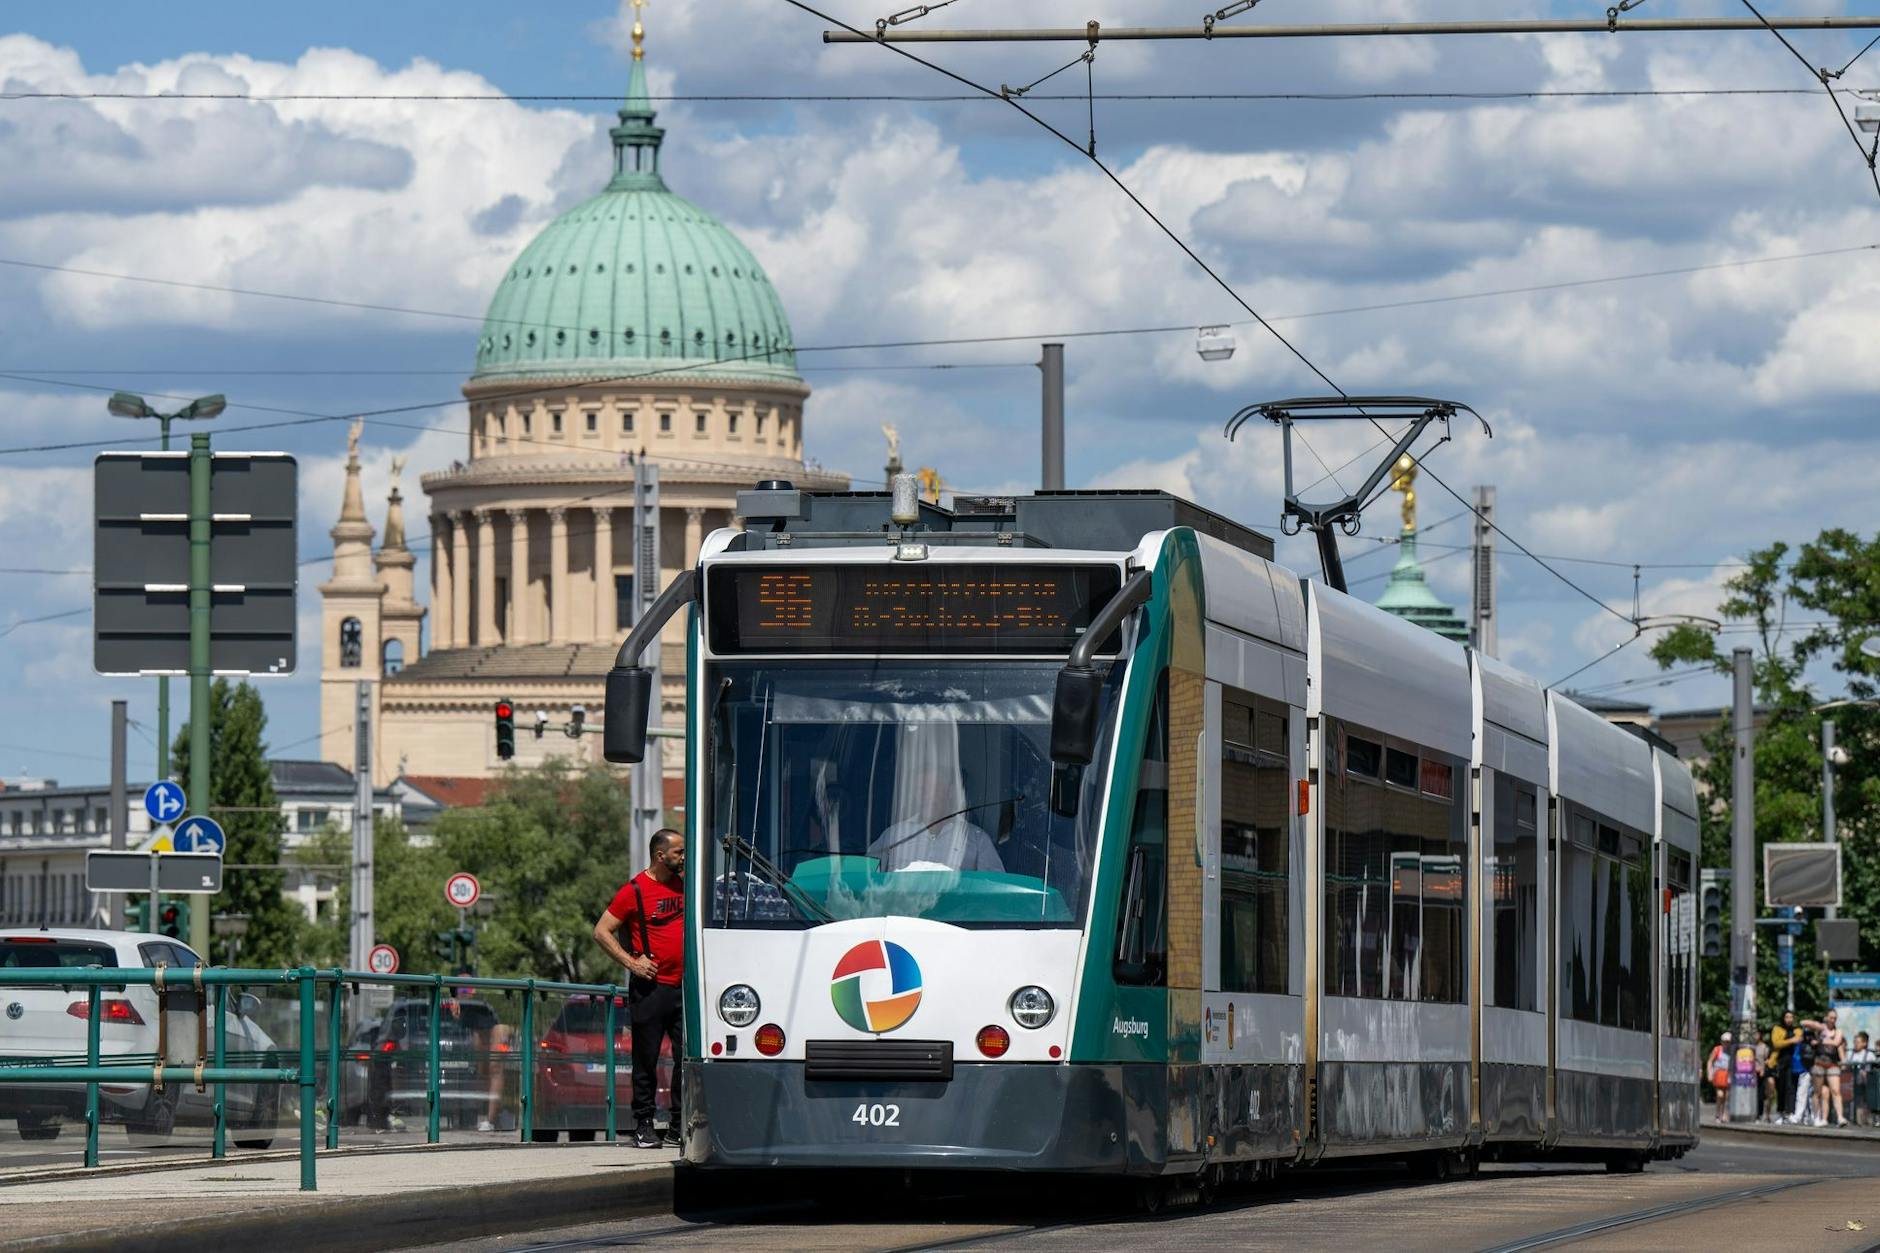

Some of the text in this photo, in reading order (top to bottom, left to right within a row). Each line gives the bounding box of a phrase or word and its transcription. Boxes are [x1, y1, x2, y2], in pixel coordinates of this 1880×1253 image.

[656, 896, 685, 914] NIKE
[375, 954, 392, 969] 30
[1112, 1016, 1149, 1039] Augsburg
[852, 1103, 900, 1127] 402
